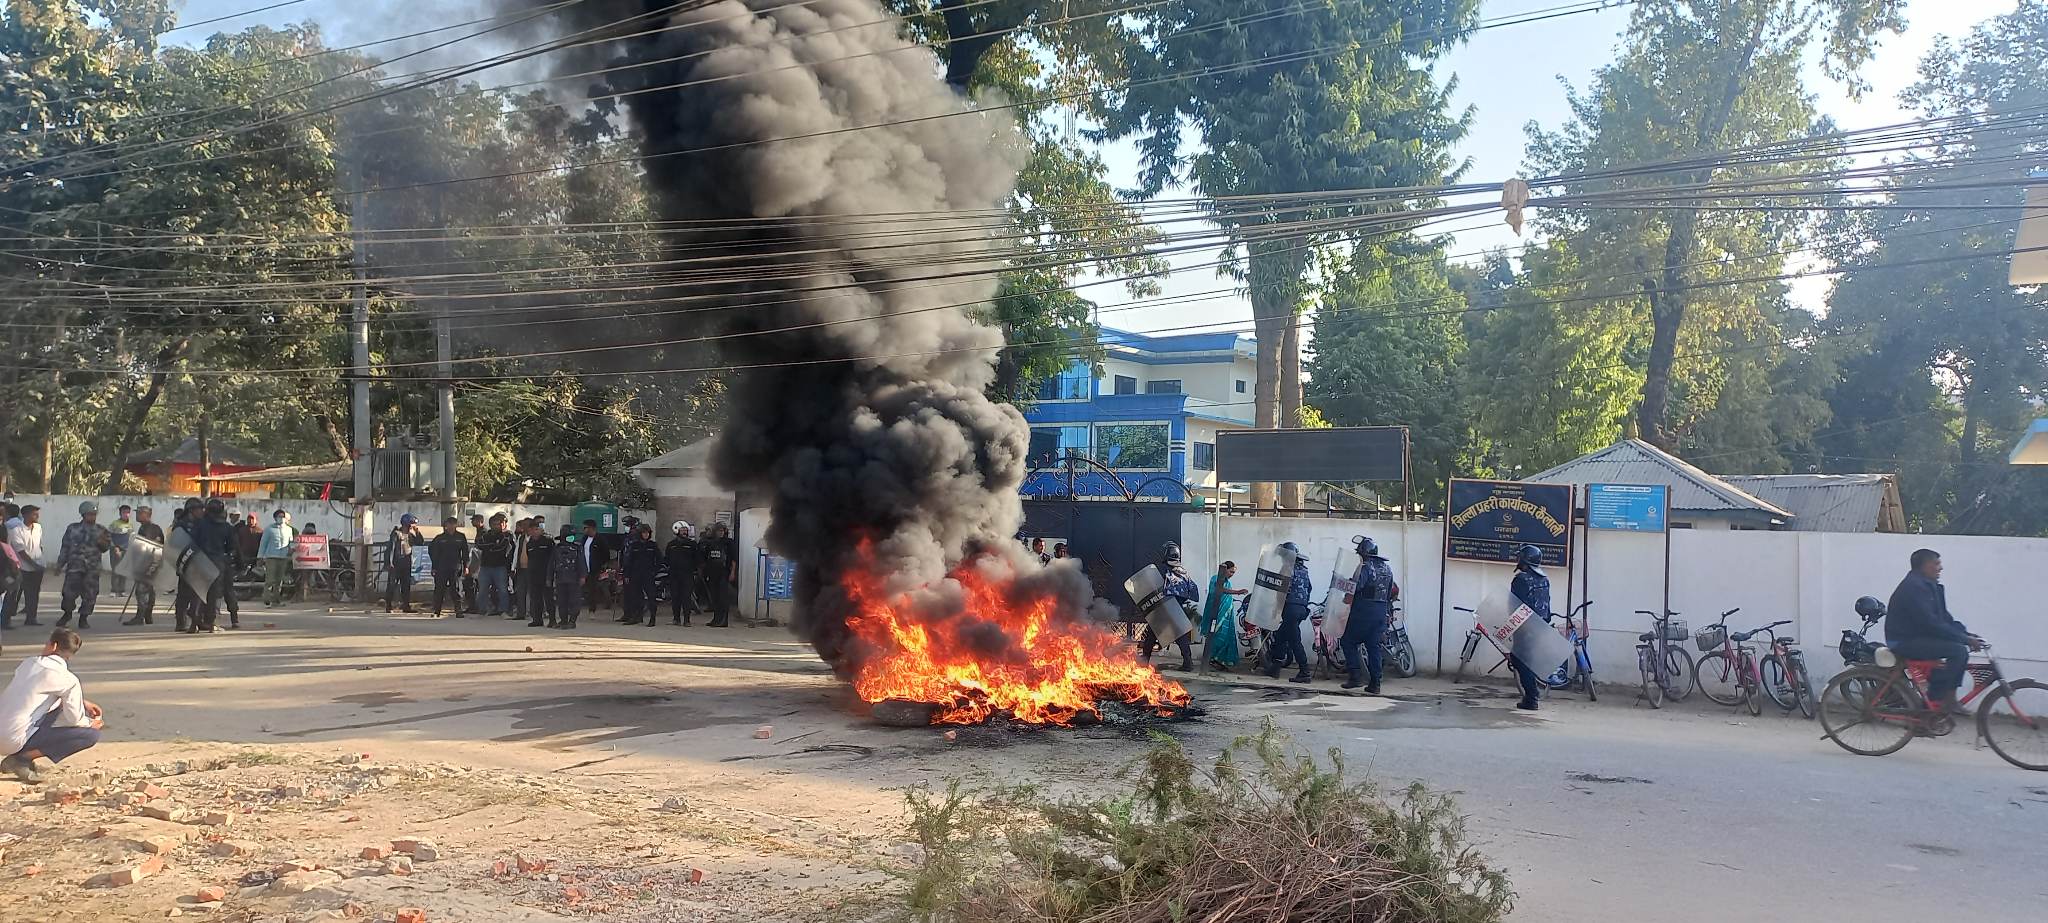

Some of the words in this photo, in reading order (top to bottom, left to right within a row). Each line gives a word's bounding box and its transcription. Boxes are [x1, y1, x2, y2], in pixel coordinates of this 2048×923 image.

[1451, 506, 1477, 530] जिल्ला
[1475, 495, 1498, 515] प्रहरी
[1499, 496, 1538, 516] कार्यालय
[1534, 505, 1565, 538] कैलाली
[301, 536, 326, 544] PARKING
[1336, 581, 1356, 593] POLICE
[1496, 623, 1514, 641] NEPAL
[1509, 605, 1532, 627] POLICE
